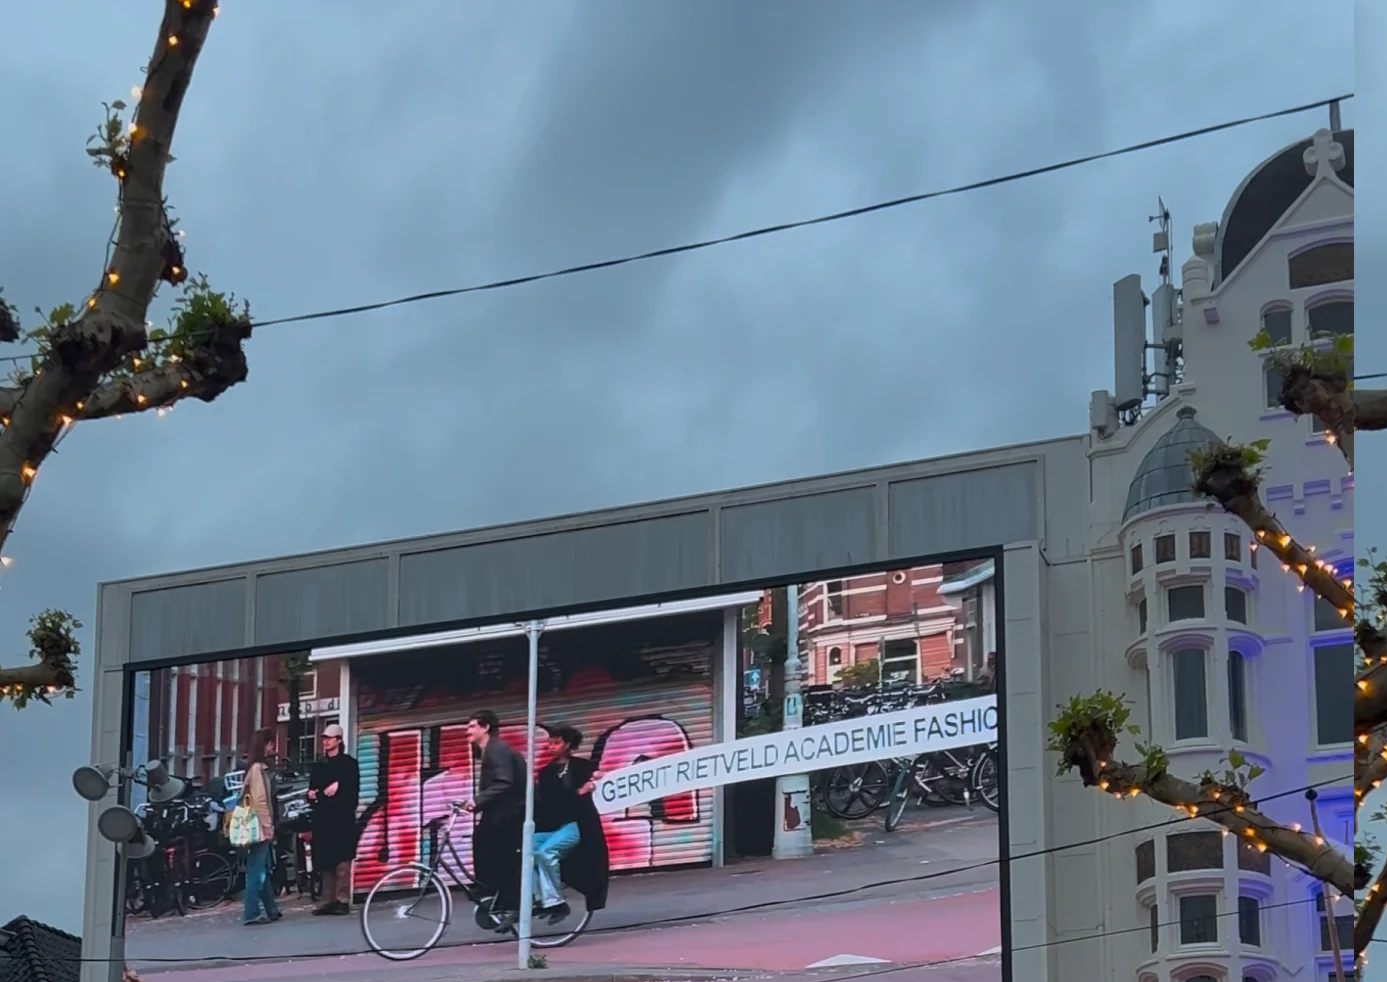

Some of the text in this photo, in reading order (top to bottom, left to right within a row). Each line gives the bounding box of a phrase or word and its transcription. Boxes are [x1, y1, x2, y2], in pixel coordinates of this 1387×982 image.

[602, 765, 672, 802] GERRIT
[676, 744, 779, 783] RIETVELD
[783, 721, 907, 764] ACADEMIE
